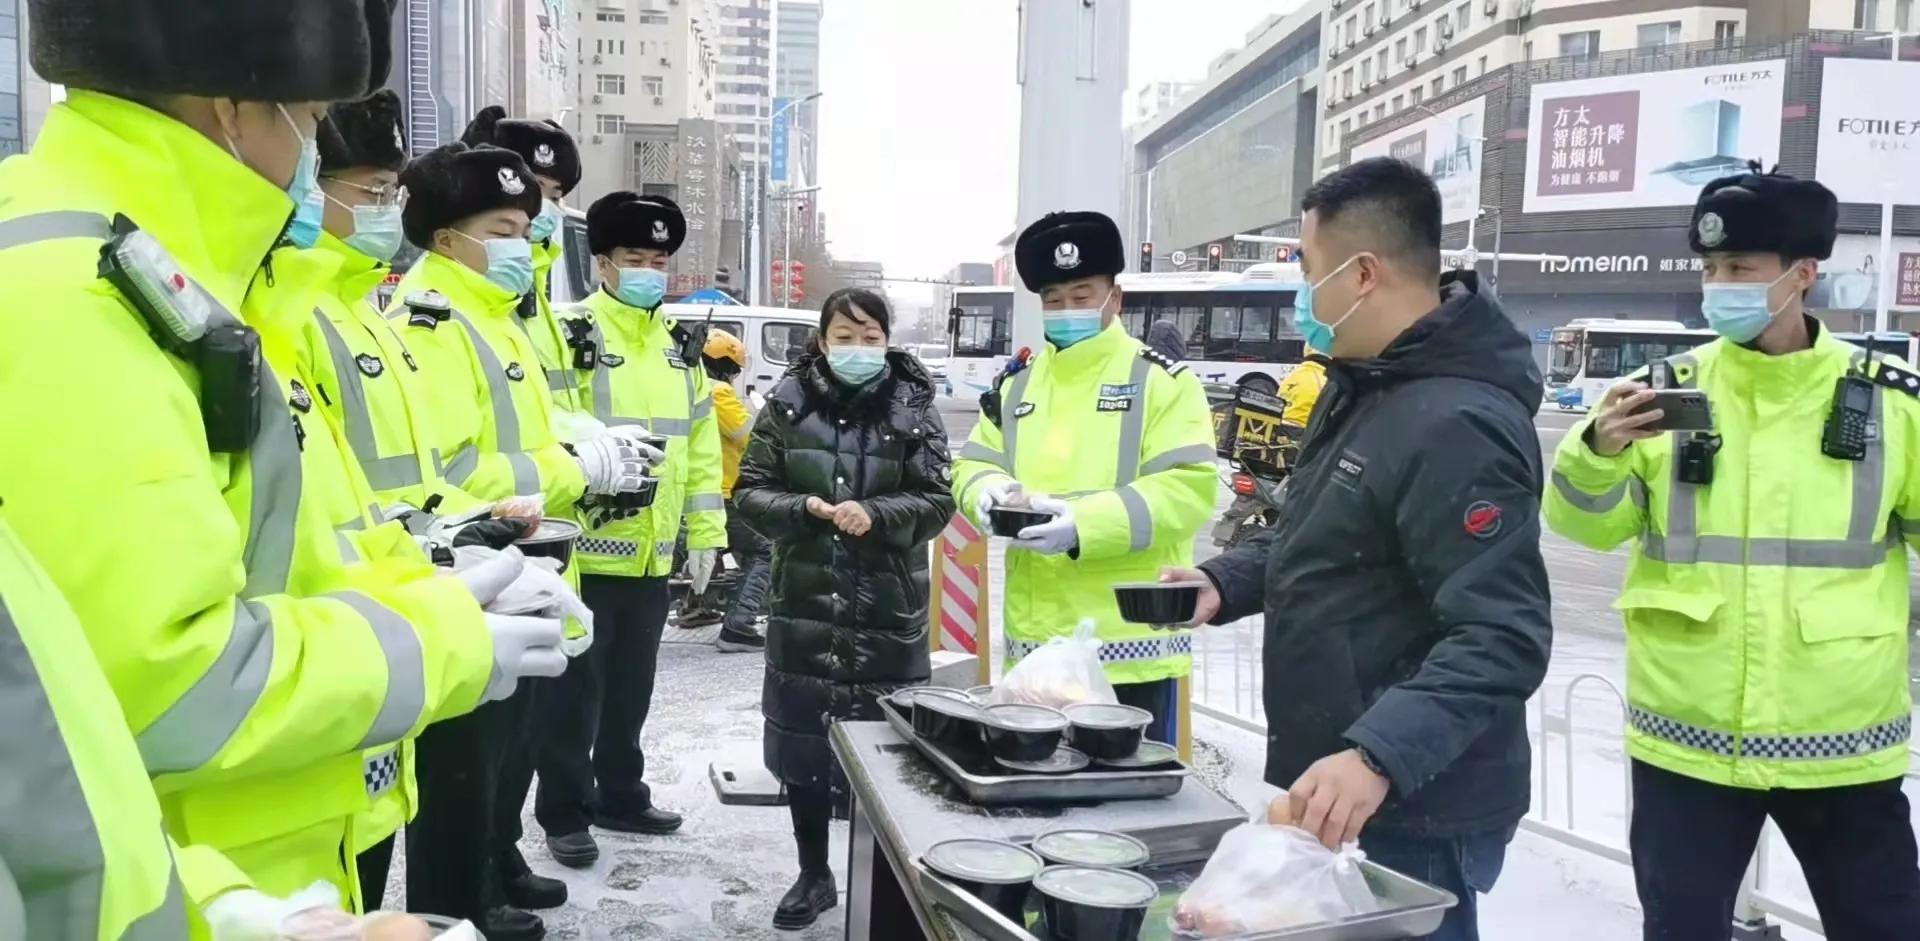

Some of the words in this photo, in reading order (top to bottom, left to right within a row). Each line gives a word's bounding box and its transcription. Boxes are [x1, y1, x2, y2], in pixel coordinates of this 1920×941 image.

[1552, 104, 1591, 128] 方太
[1552, 122, 1625, 149] 智能升降
[1551, 146, 1605, 170] 油烟机
